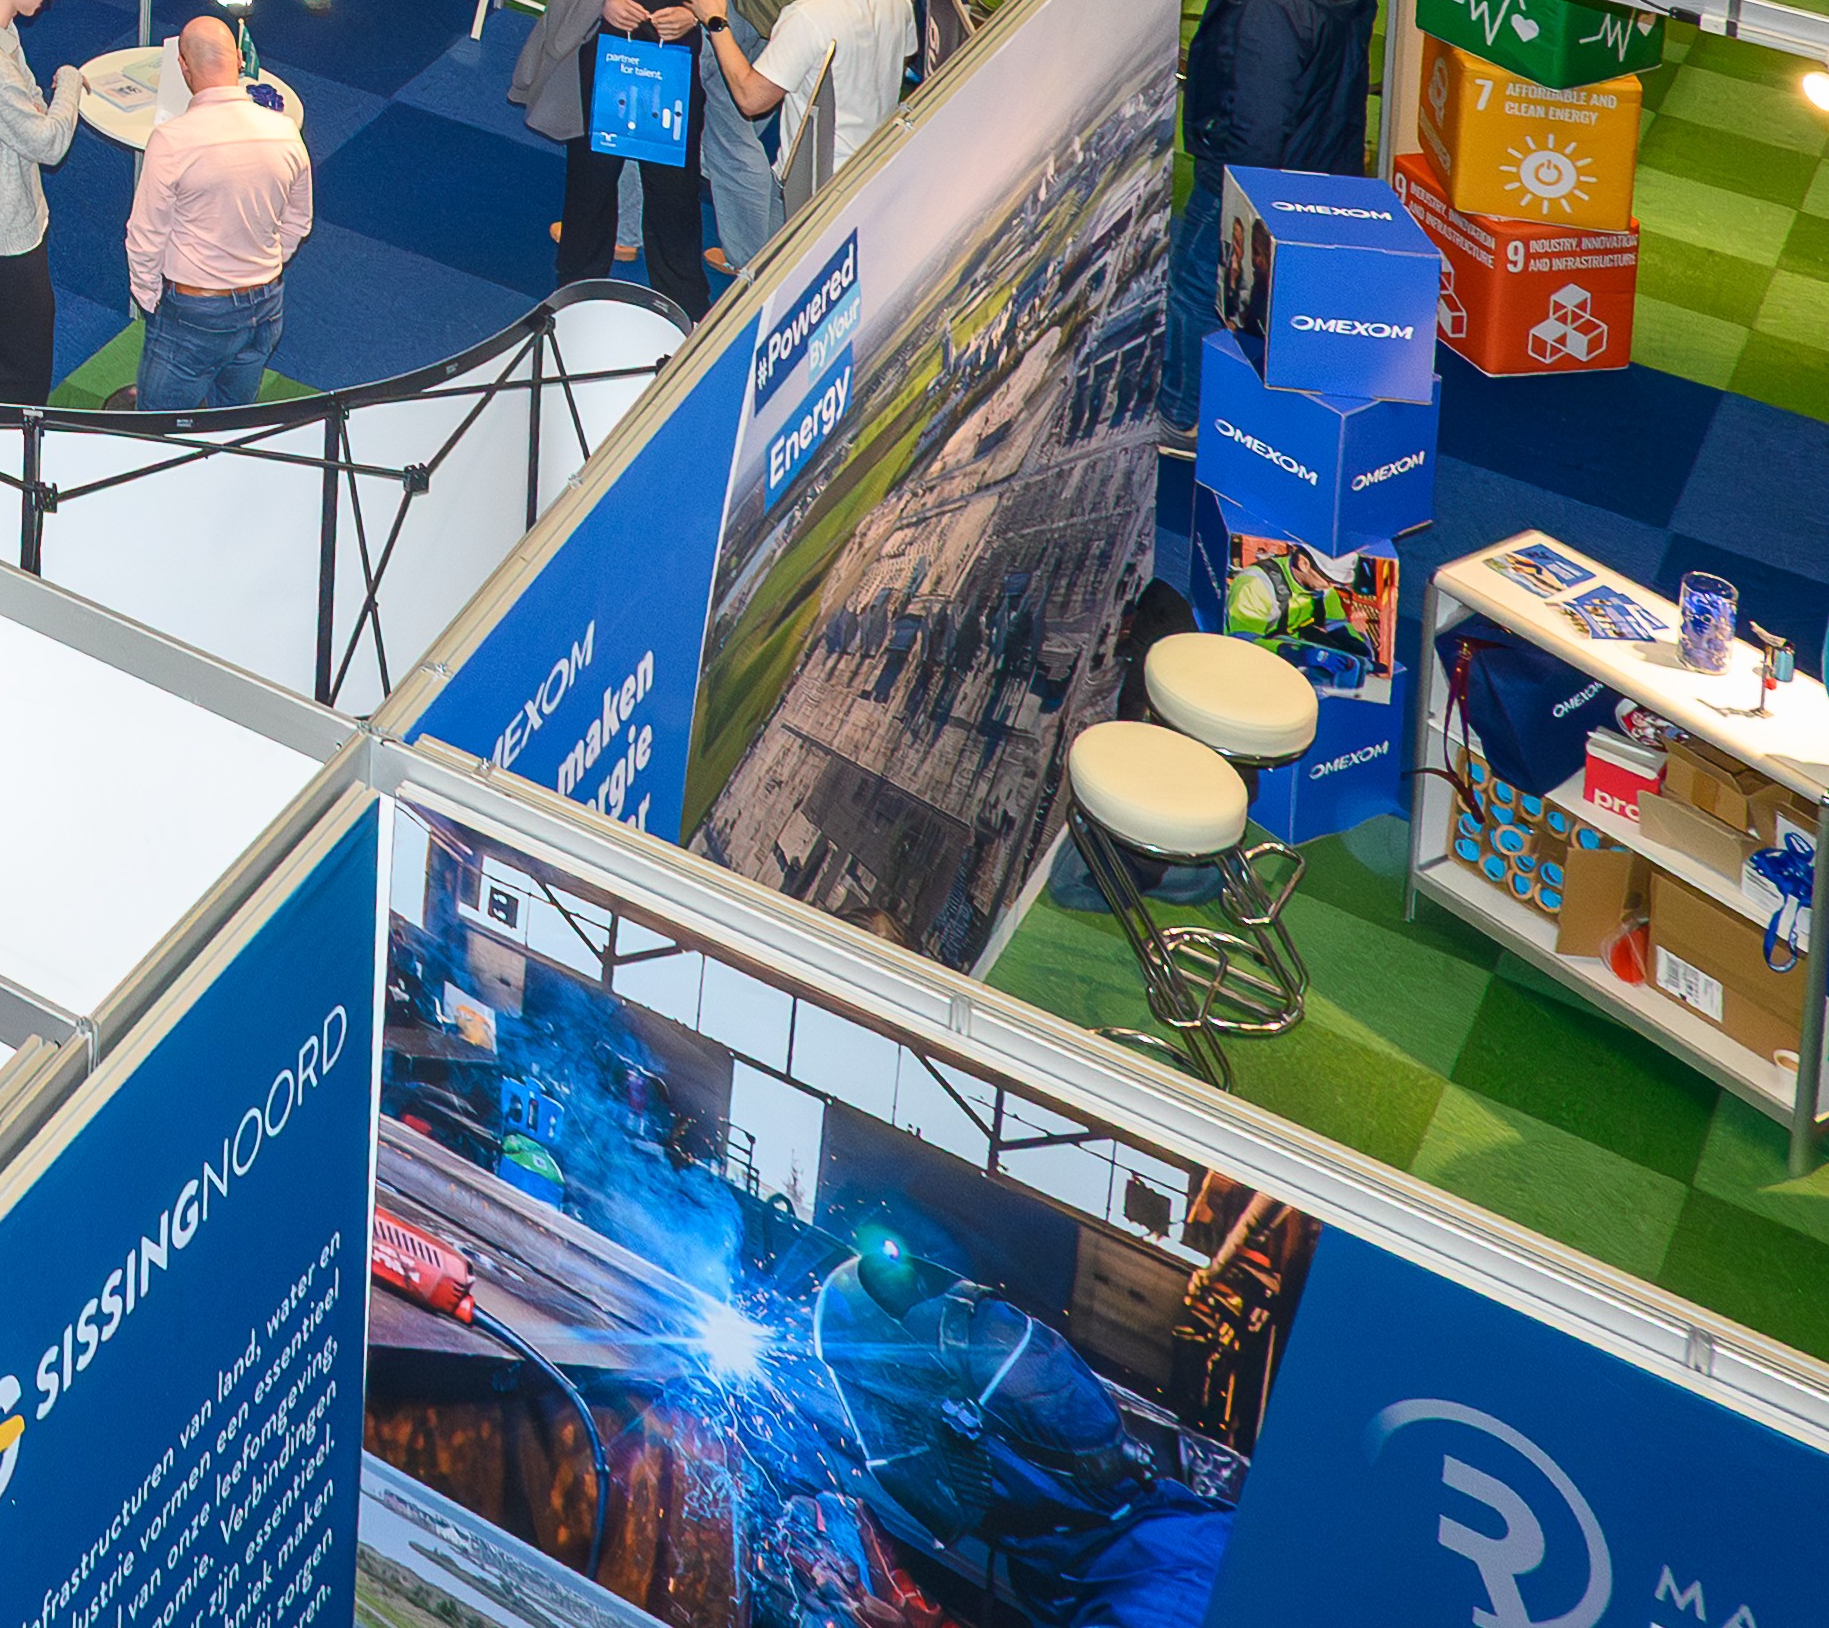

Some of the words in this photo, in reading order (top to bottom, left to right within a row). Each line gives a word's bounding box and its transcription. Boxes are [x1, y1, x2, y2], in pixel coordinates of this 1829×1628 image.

[605, 51, 641, 67] partner
[620, 62, 634, 76] for
[634, 63, 663, 82] talent.
[1474, 78, 1493, 111] 7
[1505, 82, 1590, 107] AFFORDABLE
[1590, 92, 1618, 110] AND
[1504, 99, 1546, 119] CLEAN
[1547, 105, 1599, 126] ENERGY
[1270, 200, 1393, 223] OMEXOM
[1394, 172, 1407, 205] 9
[1409, 180, 1449, 220] INDUSTRY,
[1409, 202, 1425, 221] AND
[1425, 211, 1496, 270] INFRASTRUCTURE
[1506, 239, 1525, 273] 9
[1529, 237, 1581, 254] INDUSTRY,
[1581, 233, 1639, 251] INNOVATION
[1529, 258, 1550, 272] AND
[1551, 252, 1637, 271] INFRASTRUCTURE
[754, 242, 857, 392] #Powered
[1289, 313, 1416, 341] OMEXOM
[768, 365, 852, 487] Energy
[1213, 417, 1320, 488] OMEXOM
[1350, 449, 1427, 492] OMEXOM
[556, 647, 654, 796] maken
[1307, 739, 1391, 781] OMEXOM
[35, 1001, 348, 1422] SISSINGNOORD
[179, 1399, 213, 1450] van
[216, 1327, 262, 1403] land,
[265, 1264, 316, 1339] water
[318, 1230, 342, 1269] en
[140, 1450, 212, 1553] vormen
[215, 1405, 250, 1455] een
[253, 1267, 341, 1404] essentieel
[128, 1571, 162, 1622] van
[167, 1501, 211, 1572] onze
[215, 1334, 339, 1508] leefomgeving,
[220, 1379, 337, 1546] Verbindingen
[209, 1557, 240, 1616] zijn
[244, 1423, 335, 1567] essentieel.
[277, 1478, 335, 1570] maken
[276, 1526, 333, 1621] zorgen
